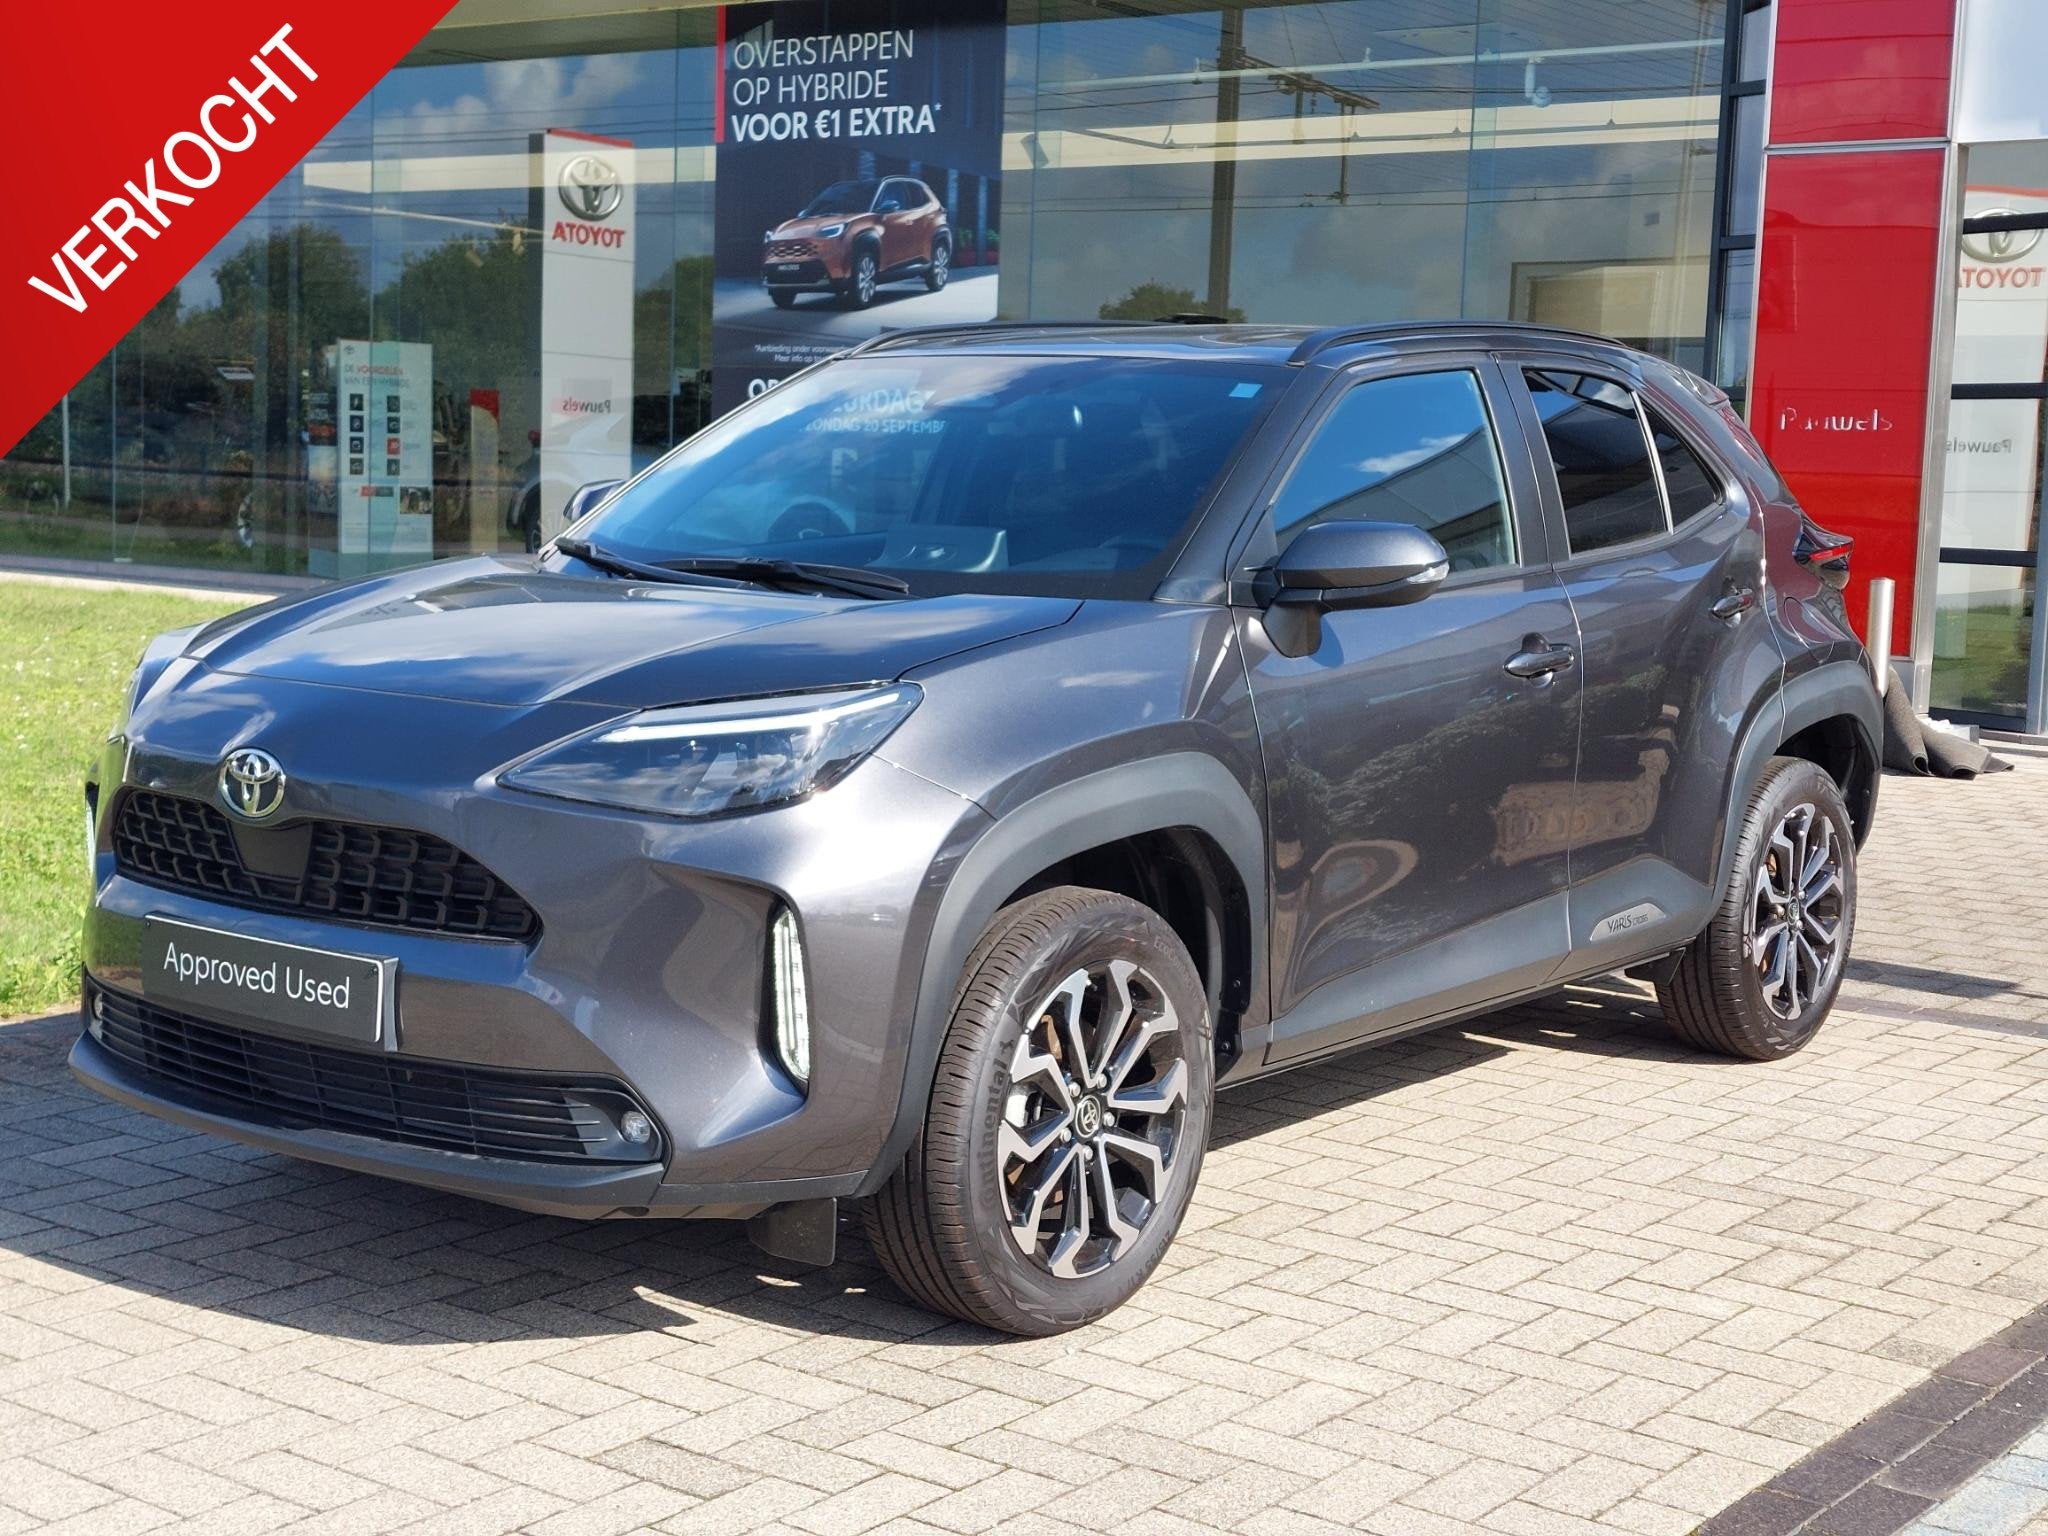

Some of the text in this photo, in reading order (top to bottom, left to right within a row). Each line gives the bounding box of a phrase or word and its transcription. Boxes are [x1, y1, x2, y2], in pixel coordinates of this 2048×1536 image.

[734, 29, 914, 69] OVERSTAPPEN
[733, 69, 888, 106] OP HYBRIDE
[731, 111, 809, 142] VOOR
[814, 108, 841, 139] €1
[163, 942, 350, 1009] Approved Used
